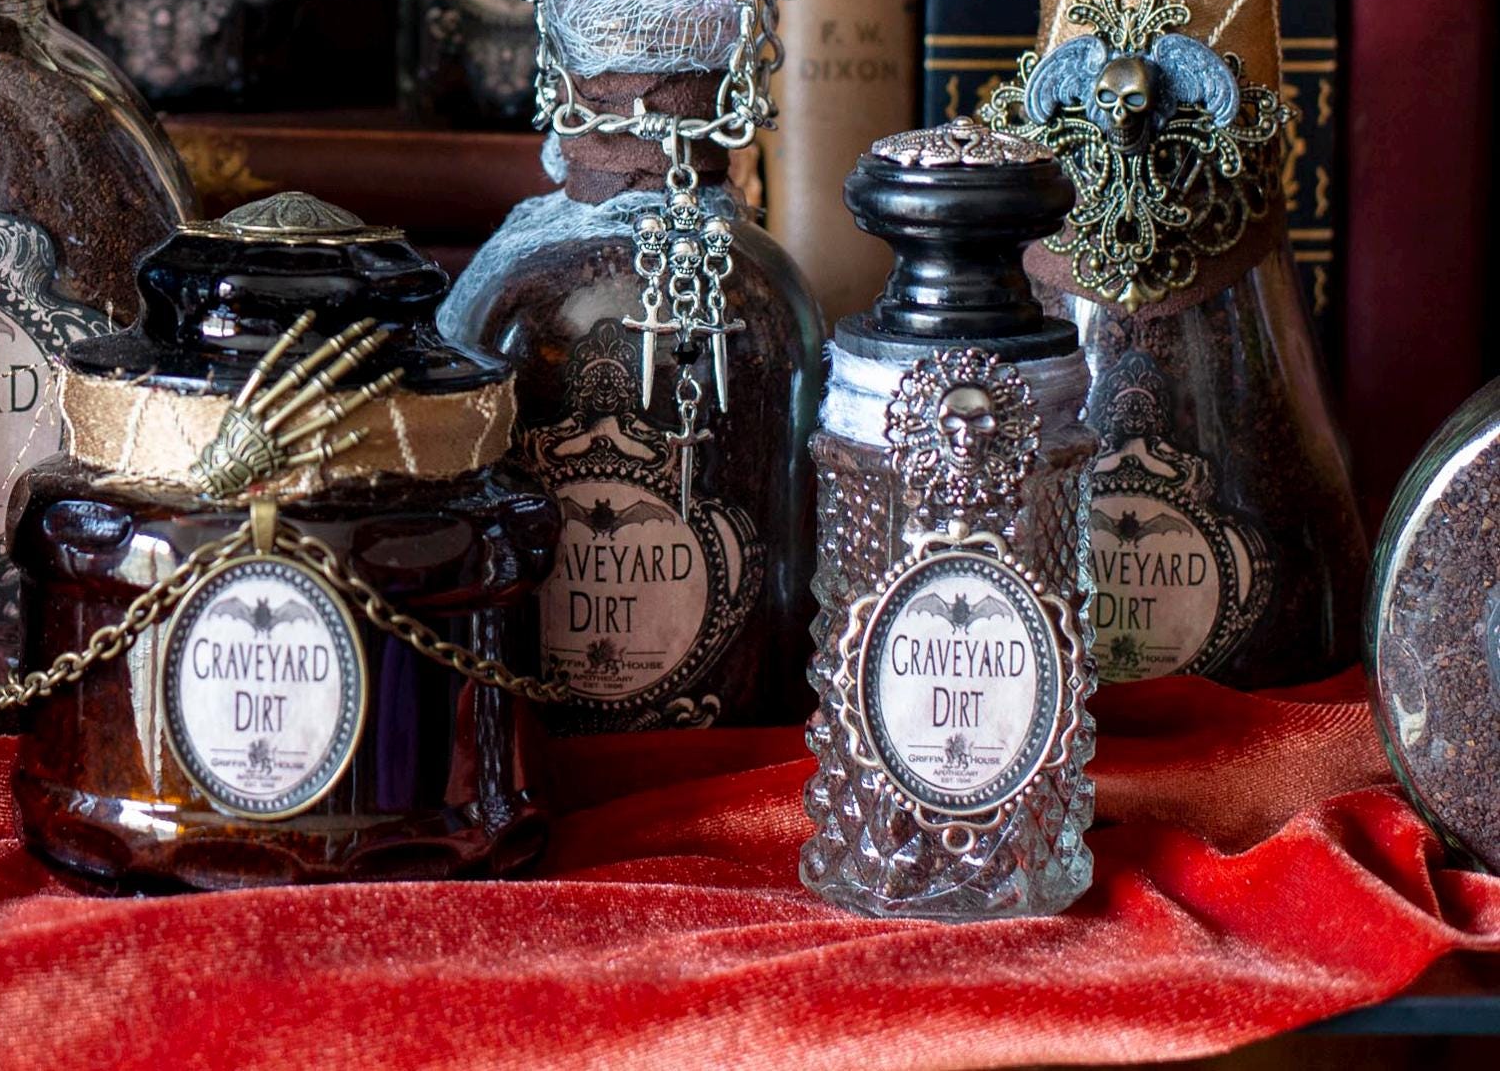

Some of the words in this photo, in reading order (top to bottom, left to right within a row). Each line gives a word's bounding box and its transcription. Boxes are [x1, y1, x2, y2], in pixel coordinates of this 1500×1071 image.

[801, 58, 898, 82] DIXON
[570, 590, 637, 633] DIRT
[1096, 593, 1157, 630] DIRT
[193, 638, 329, 682] GRAVEYARD
[622, 660, 664, 671] HOUSE
[892, 634, 1026, 678] GRAVEYARD
[235, 691, 286, 732] DIRT
[932, 686, 984, 728] DIRT
[908, 754, 944, 763] GRIFFIN
[970, 755, 1000, 765] HOUSE
